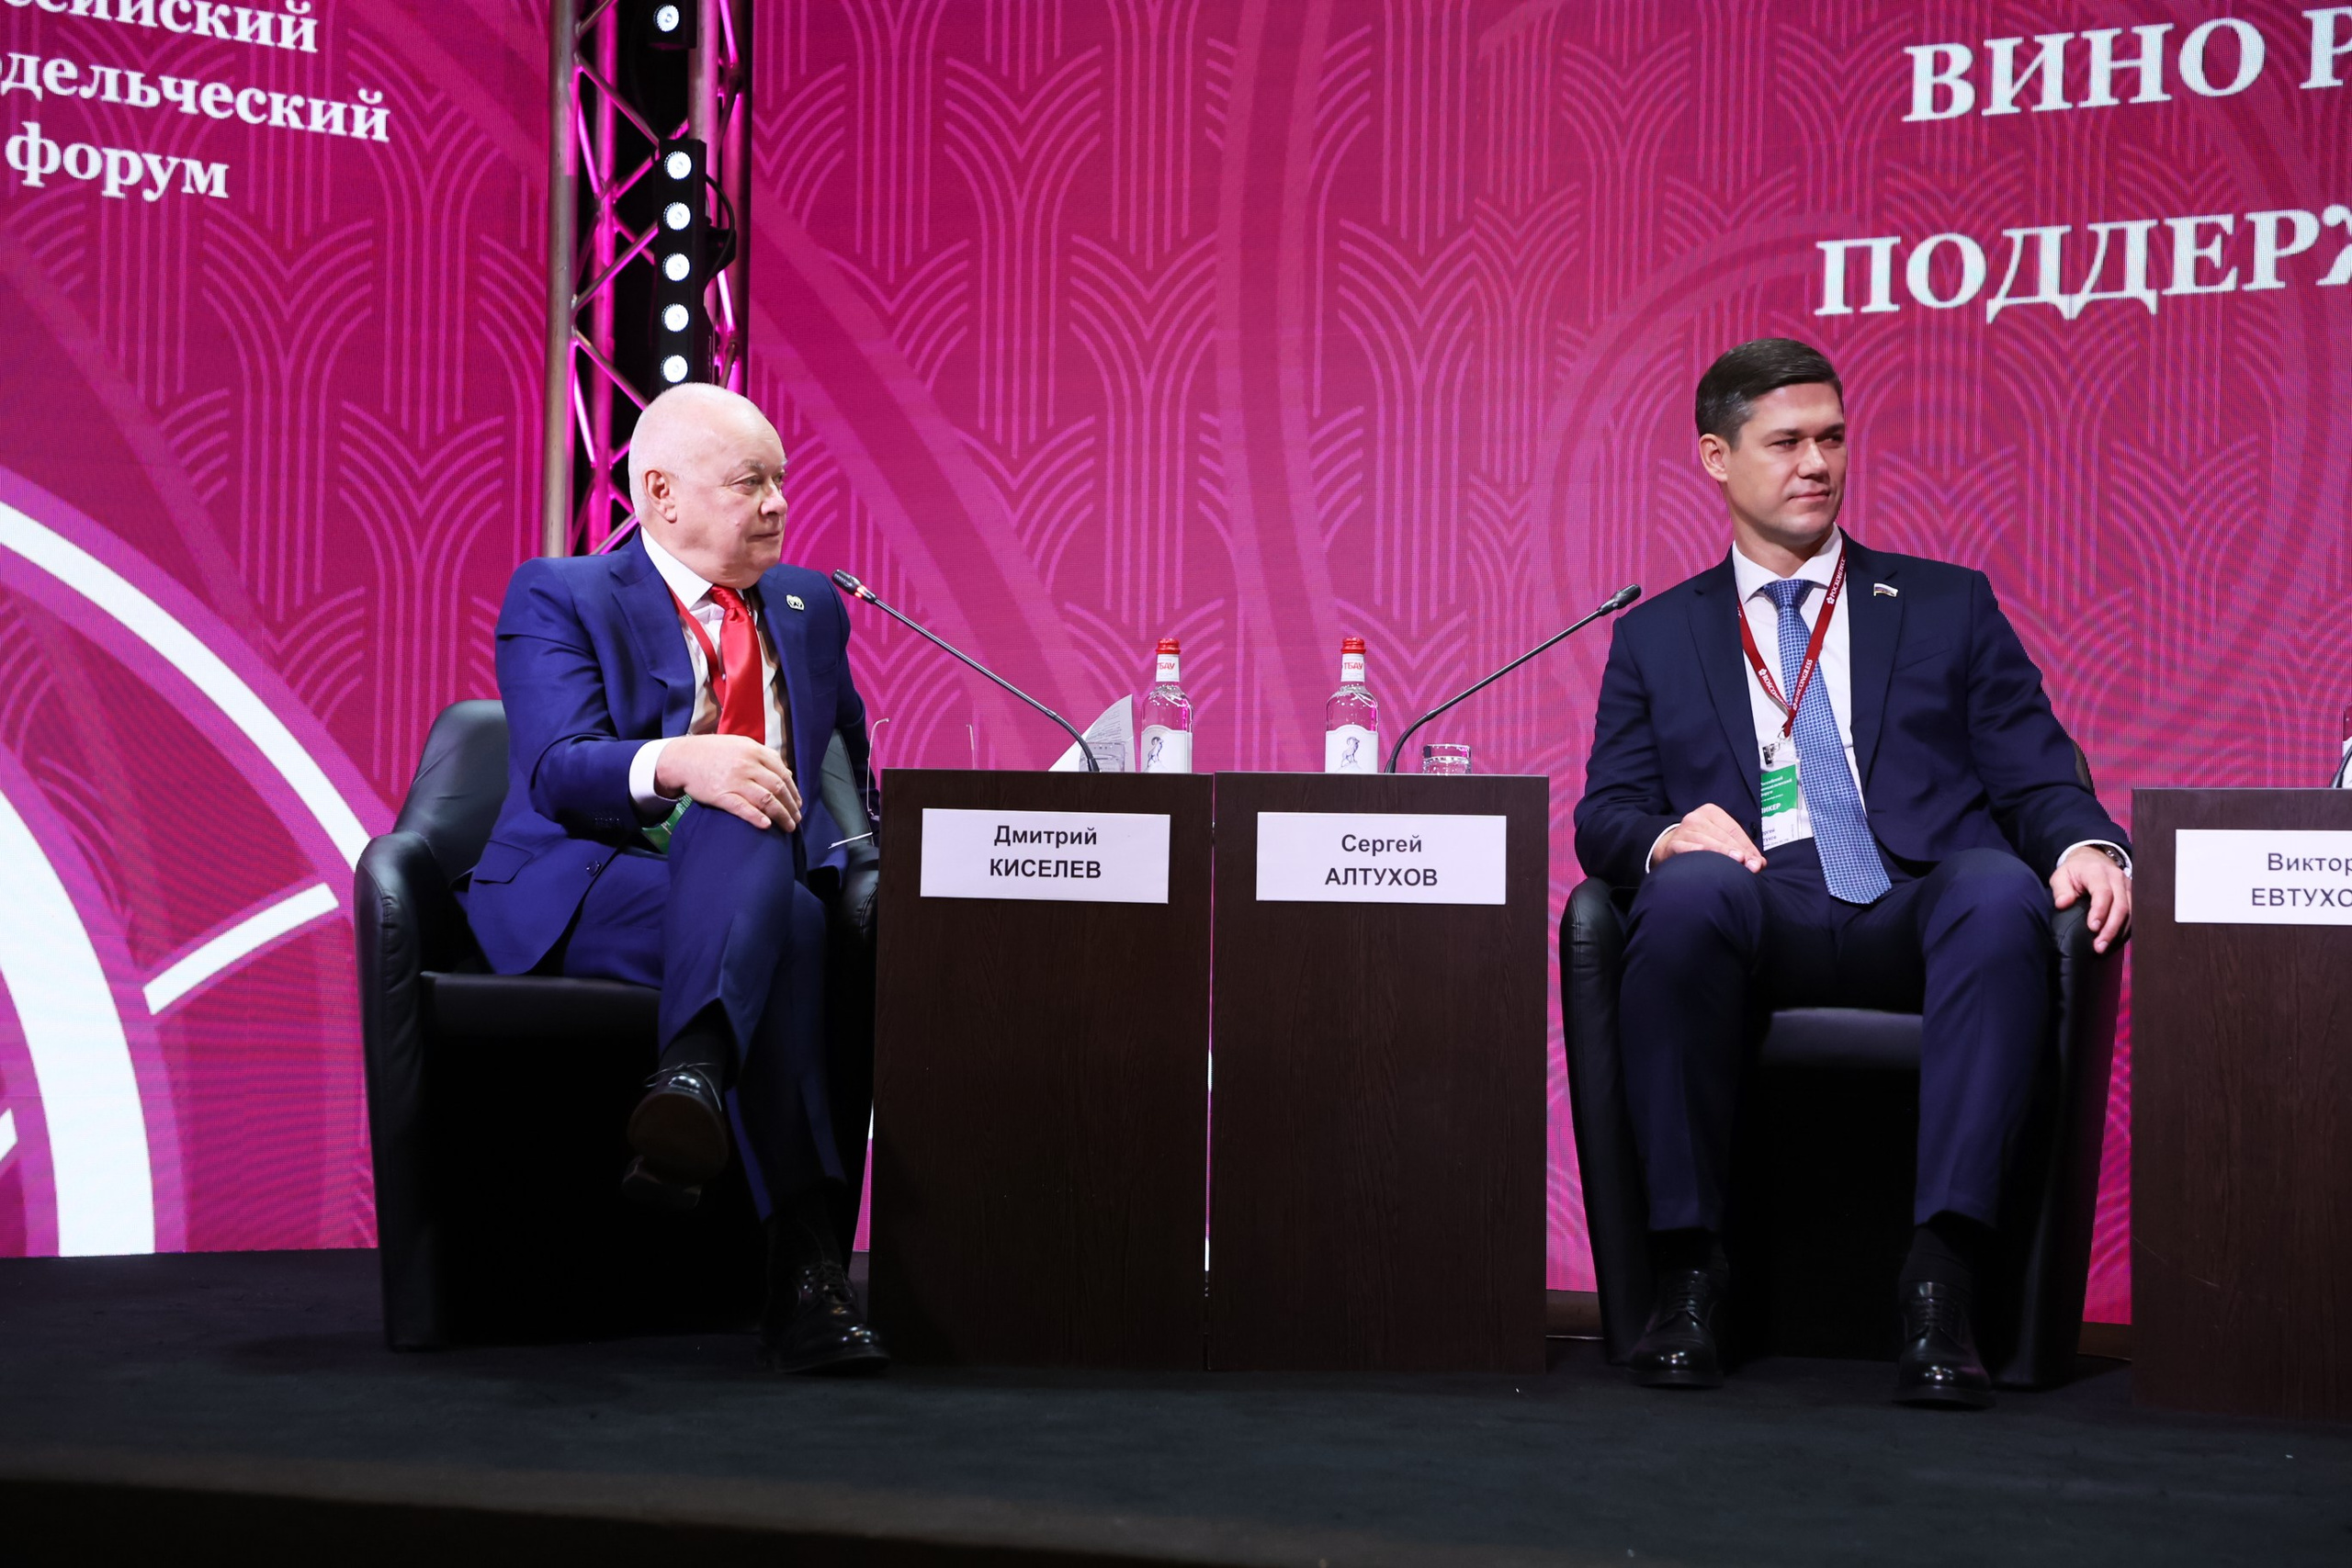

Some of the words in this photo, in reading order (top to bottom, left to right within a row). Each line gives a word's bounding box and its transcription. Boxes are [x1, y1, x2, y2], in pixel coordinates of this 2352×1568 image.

[1902, 17, 2266, 122] ВИНО
[0, 52, 390, 142] дельческий
[5, 121, 230, 202] форум
[1343, 661, 1363, 671] ТБАУ
[993, 825, 1097, 849] Дмитрий
[1341, 834, 1422, 857] Сергей
[989, 858, 1102, 878] КИСЕЛЕВ
[2267, 852, 2352, 876] Виктор
[1325, 867, 1438, 886] АЛТУХОВ
[2252, 887, 2352, 908] ЕВТУХО
